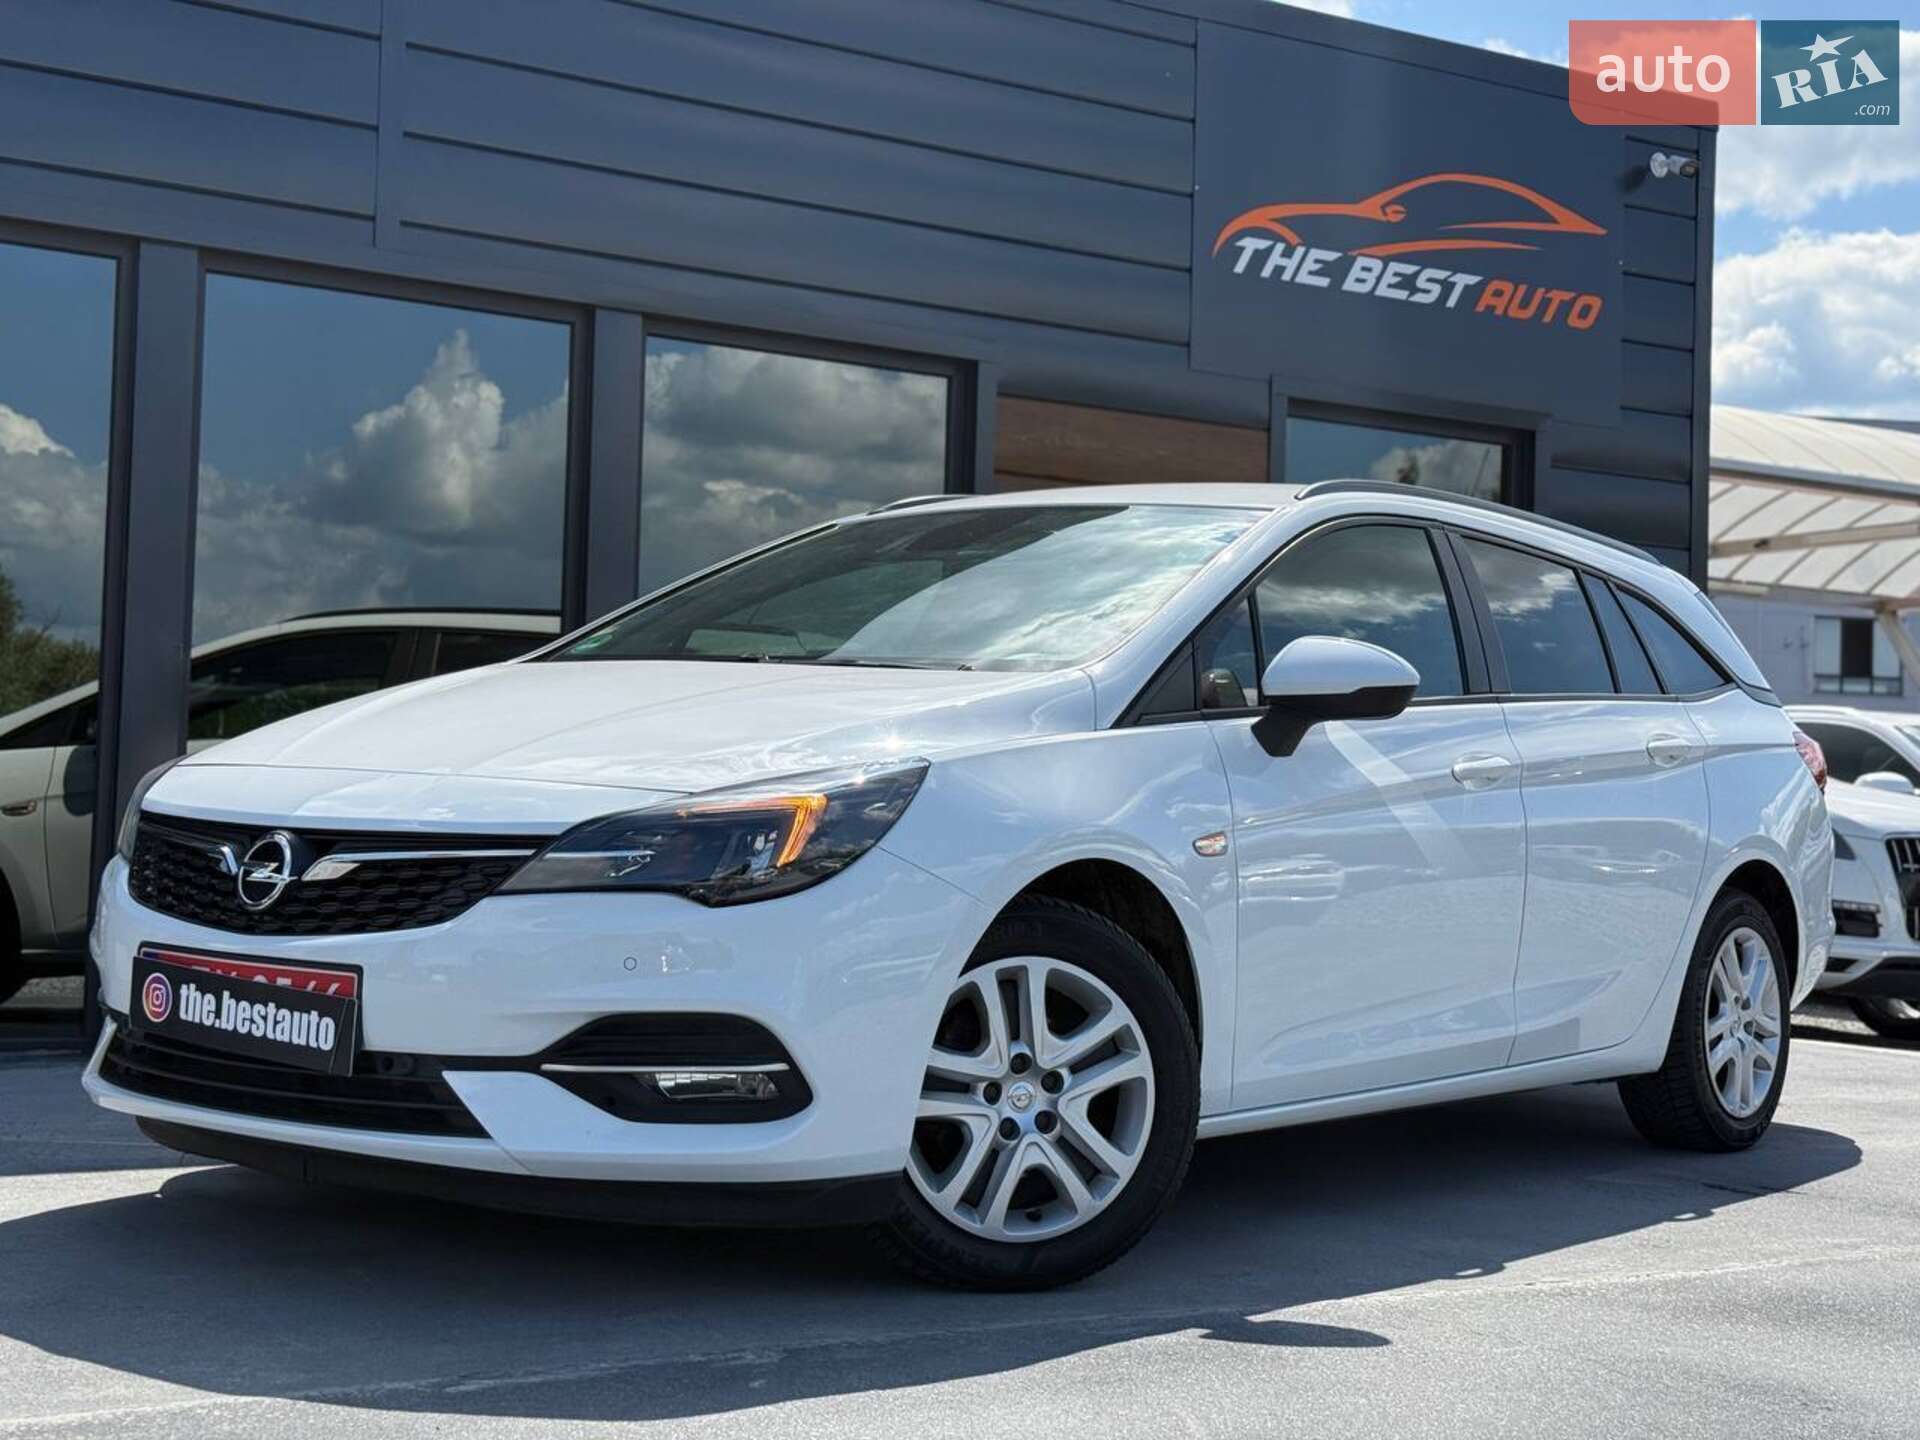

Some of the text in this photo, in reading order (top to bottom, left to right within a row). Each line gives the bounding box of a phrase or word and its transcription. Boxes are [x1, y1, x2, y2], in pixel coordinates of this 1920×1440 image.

[1233, 236, 1603, 330] THE BEST AUTO
[179, 983, 335, 1050] the.bestauto
